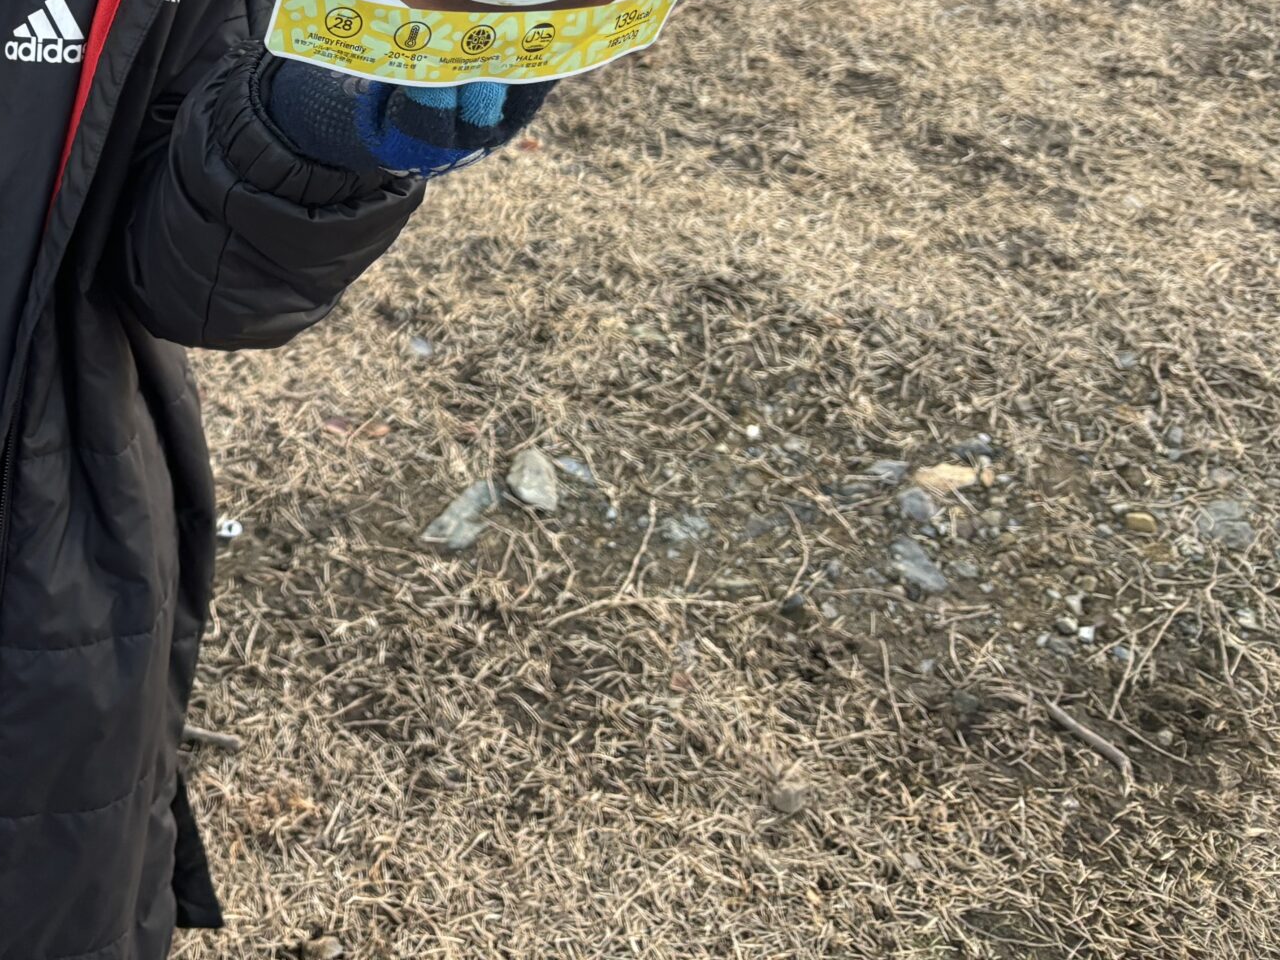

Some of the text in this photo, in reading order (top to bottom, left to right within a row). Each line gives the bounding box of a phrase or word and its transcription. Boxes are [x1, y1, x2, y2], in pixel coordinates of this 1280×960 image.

[333, 16, 353, 31] 28
[308, 32, 366, 54] Allergy Friendly
[516, 54, 543, 62] HALAL
